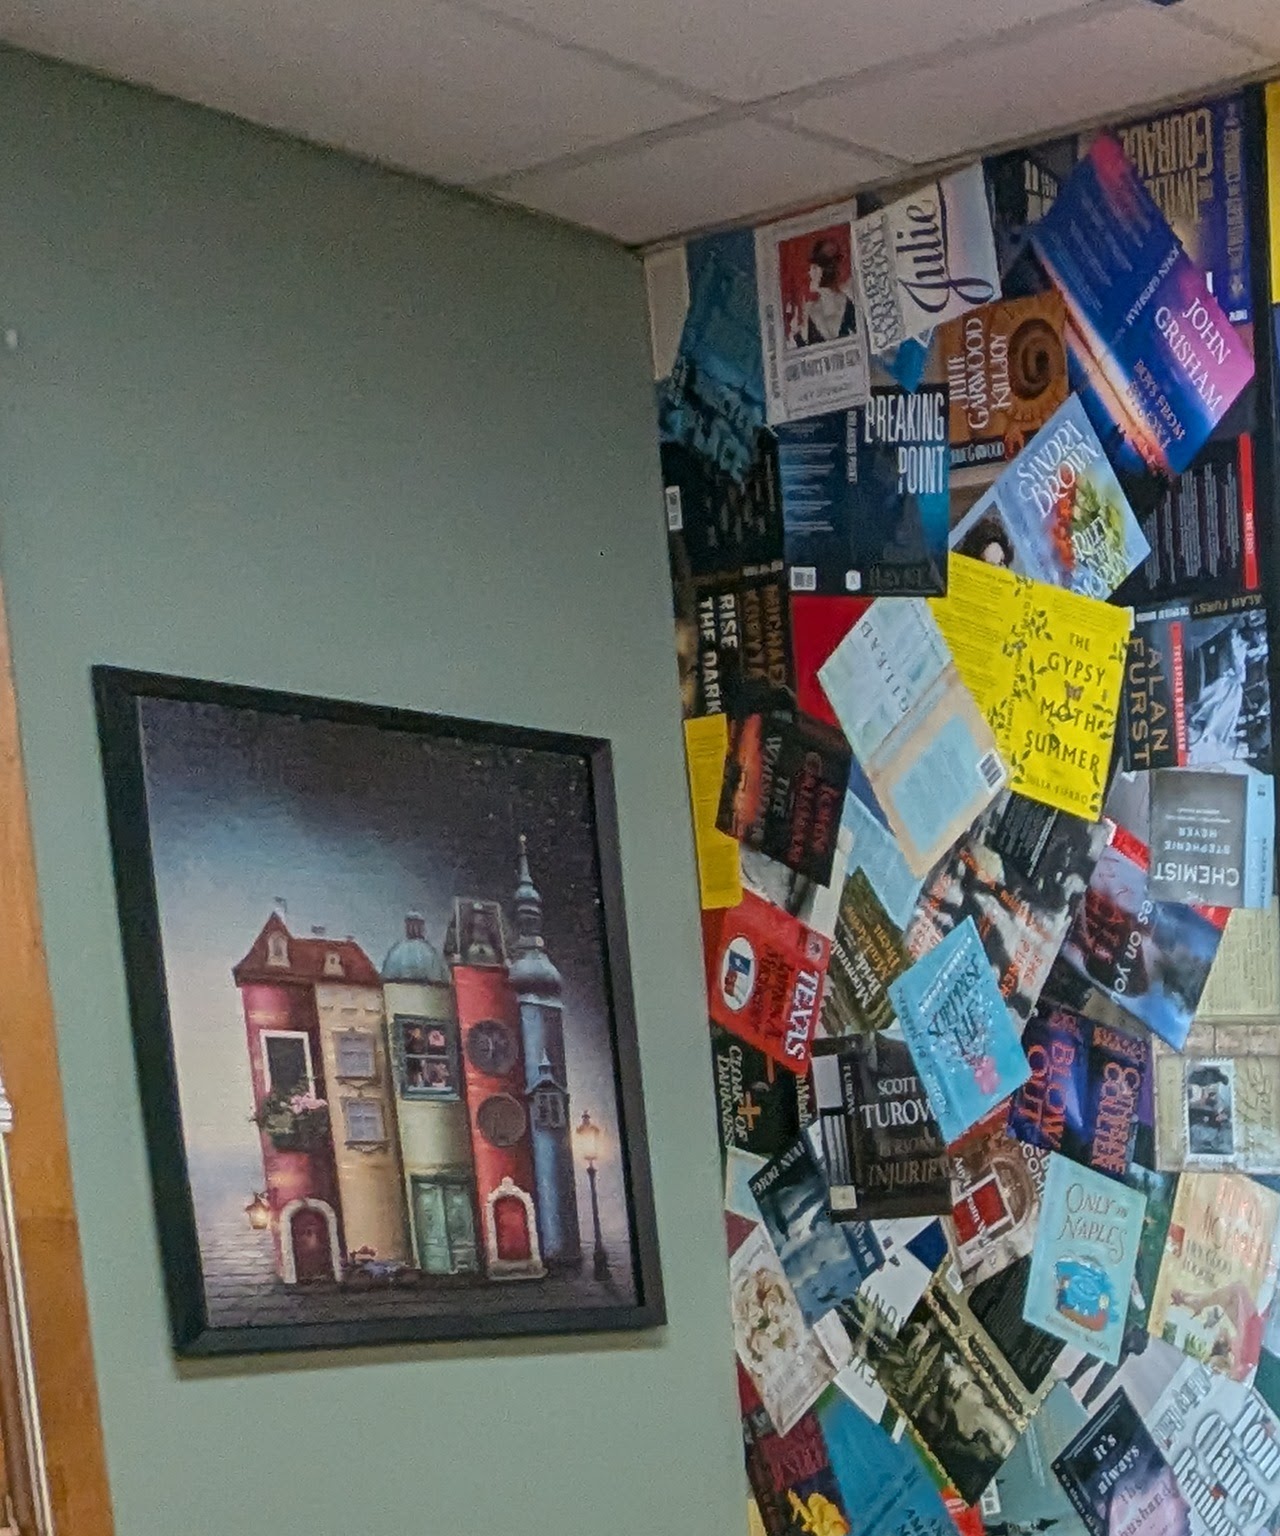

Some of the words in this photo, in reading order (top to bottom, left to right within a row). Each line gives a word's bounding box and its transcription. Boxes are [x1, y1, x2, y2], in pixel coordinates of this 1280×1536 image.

[894, 198, 995, 314] Julie
[1153, 305, 1224, 409] GRISHAM
[1181, 296, 1232, 366] JOHN
[1016, 419, 1080, 496] SANDRA
[1033, 438, 1102, 517] BROWN
[1047, 652, 1105, 687] GYPSY
[1068, 632, 1091, 651] THE
[1040, 697, 1098, 733] MOTH
[1126, 638, 1153, 767] FURST
[1146, 647, 1168, 752] ALAN
[1025, 730, 1100, 773] SUMMER
[1155, 862, 1240, 887] CHEMIST
[1193, 1412, 1268, 1522] Clancy
